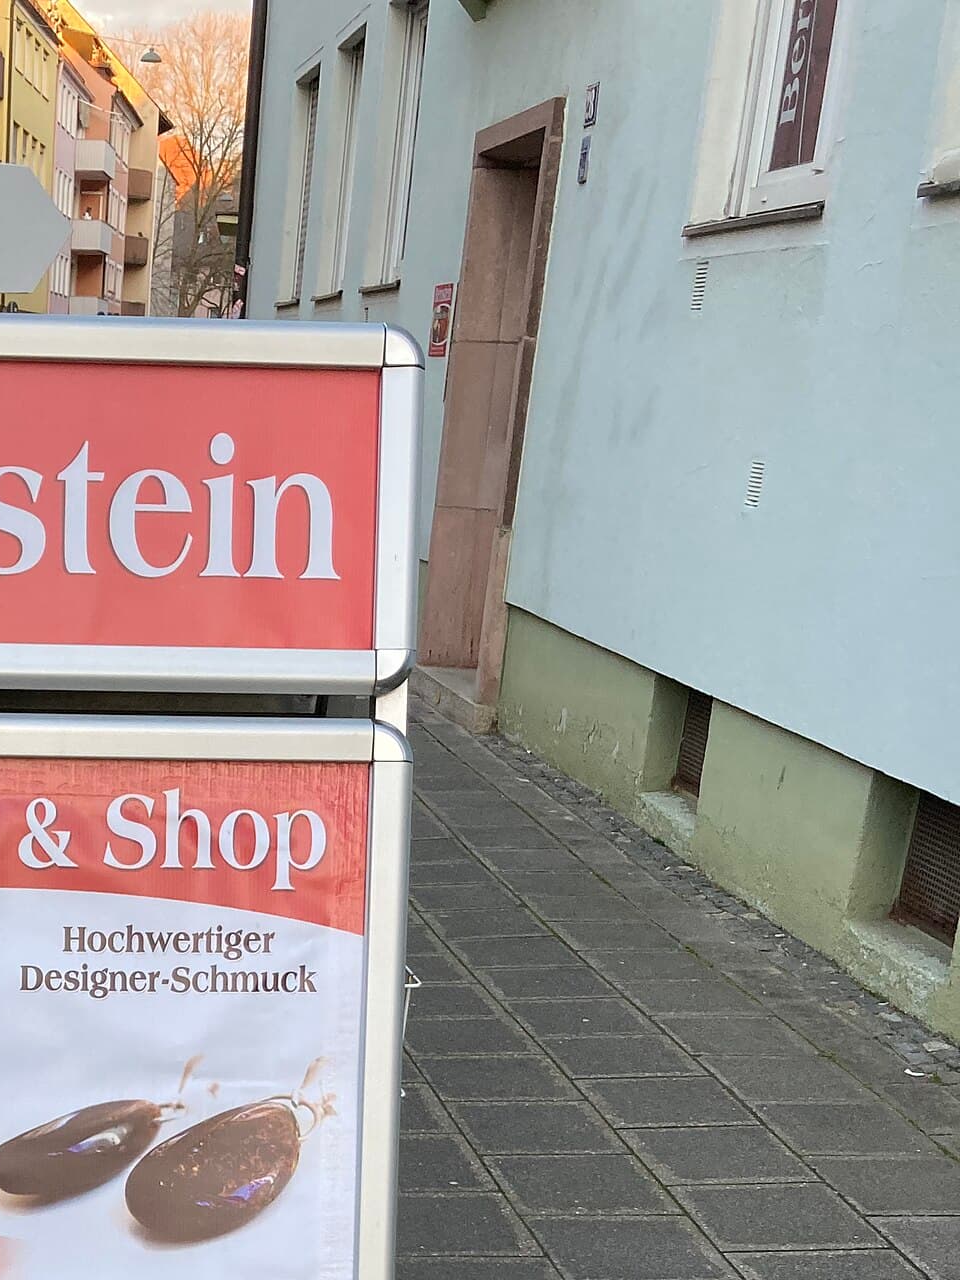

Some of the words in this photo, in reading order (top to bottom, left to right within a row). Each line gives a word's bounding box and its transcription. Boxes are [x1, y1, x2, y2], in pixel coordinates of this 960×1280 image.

[18, 798, 78, 868] &
[102, 788, 326, 892] Shop
[63, 924, 275, 960] Hochwertiger
[20, 963, 317, 998] Designer-Schmuck
